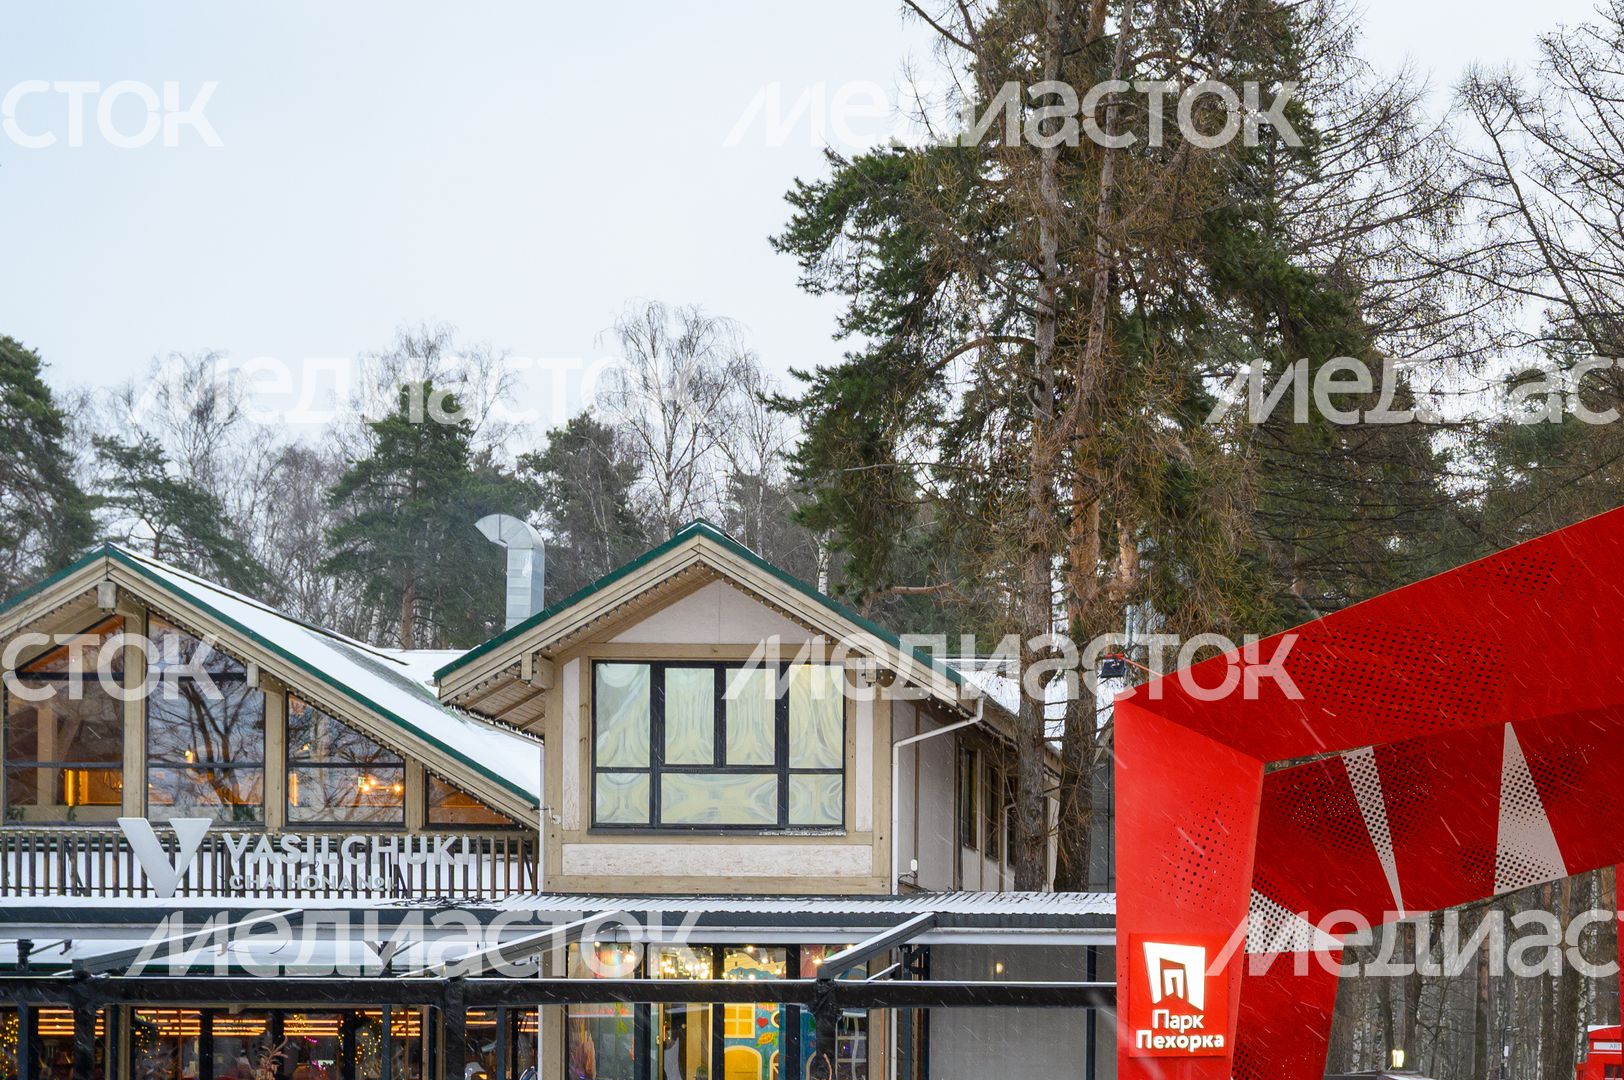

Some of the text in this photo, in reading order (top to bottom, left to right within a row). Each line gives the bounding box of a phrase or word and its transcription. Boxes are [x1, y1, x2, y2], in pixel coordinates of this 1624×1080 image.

[223, 832, 471, 866] VASILCHUKI
[229, 874, 354, 892] CHAIHONA
[1152, 1009, 1204, 1033] Парк
[1136, 1029, 1224, 1052] Пехорка
